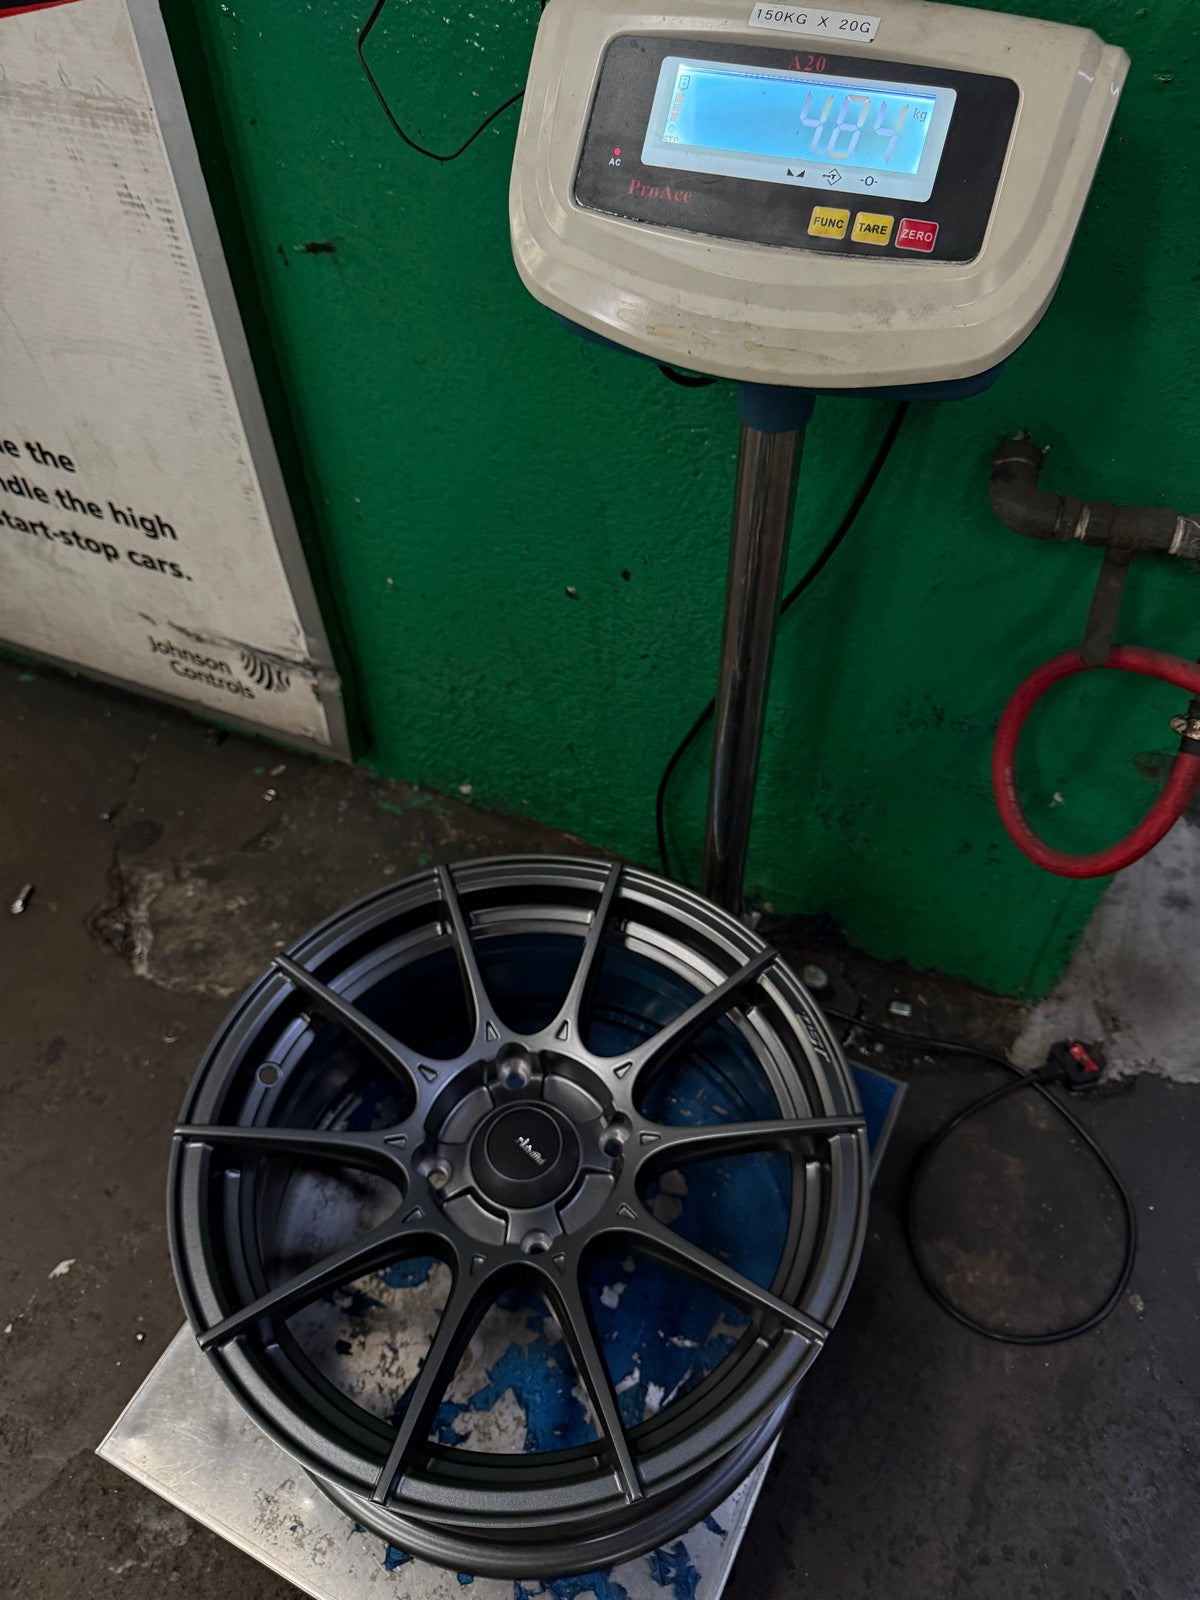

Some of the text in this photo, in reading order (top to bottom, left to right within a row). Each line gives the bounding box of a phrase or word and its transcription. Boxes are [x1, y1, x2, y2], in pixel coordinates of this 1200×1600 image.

[757, 9, 871, 34] 150KG X 20G
[788, 53, 827, 73] A20
[913, 107, 928, 122] kg
[608, 157, 622, 167] AC
[628, 178, 693, 204] ProAce
[813, 216, 844, 229] FUNC
[858, 222, 888, 235] TARE
[900, 228, 933, 243] ZERO
[25, 442, 76, 473] the
[55, 489, 103, 519] the
[108, 502, 178, 541] high
[128, 549, 193, 582] cars.
[148, 635, 232, 676] Johnson
[170, 660, 255, 700] Controls
